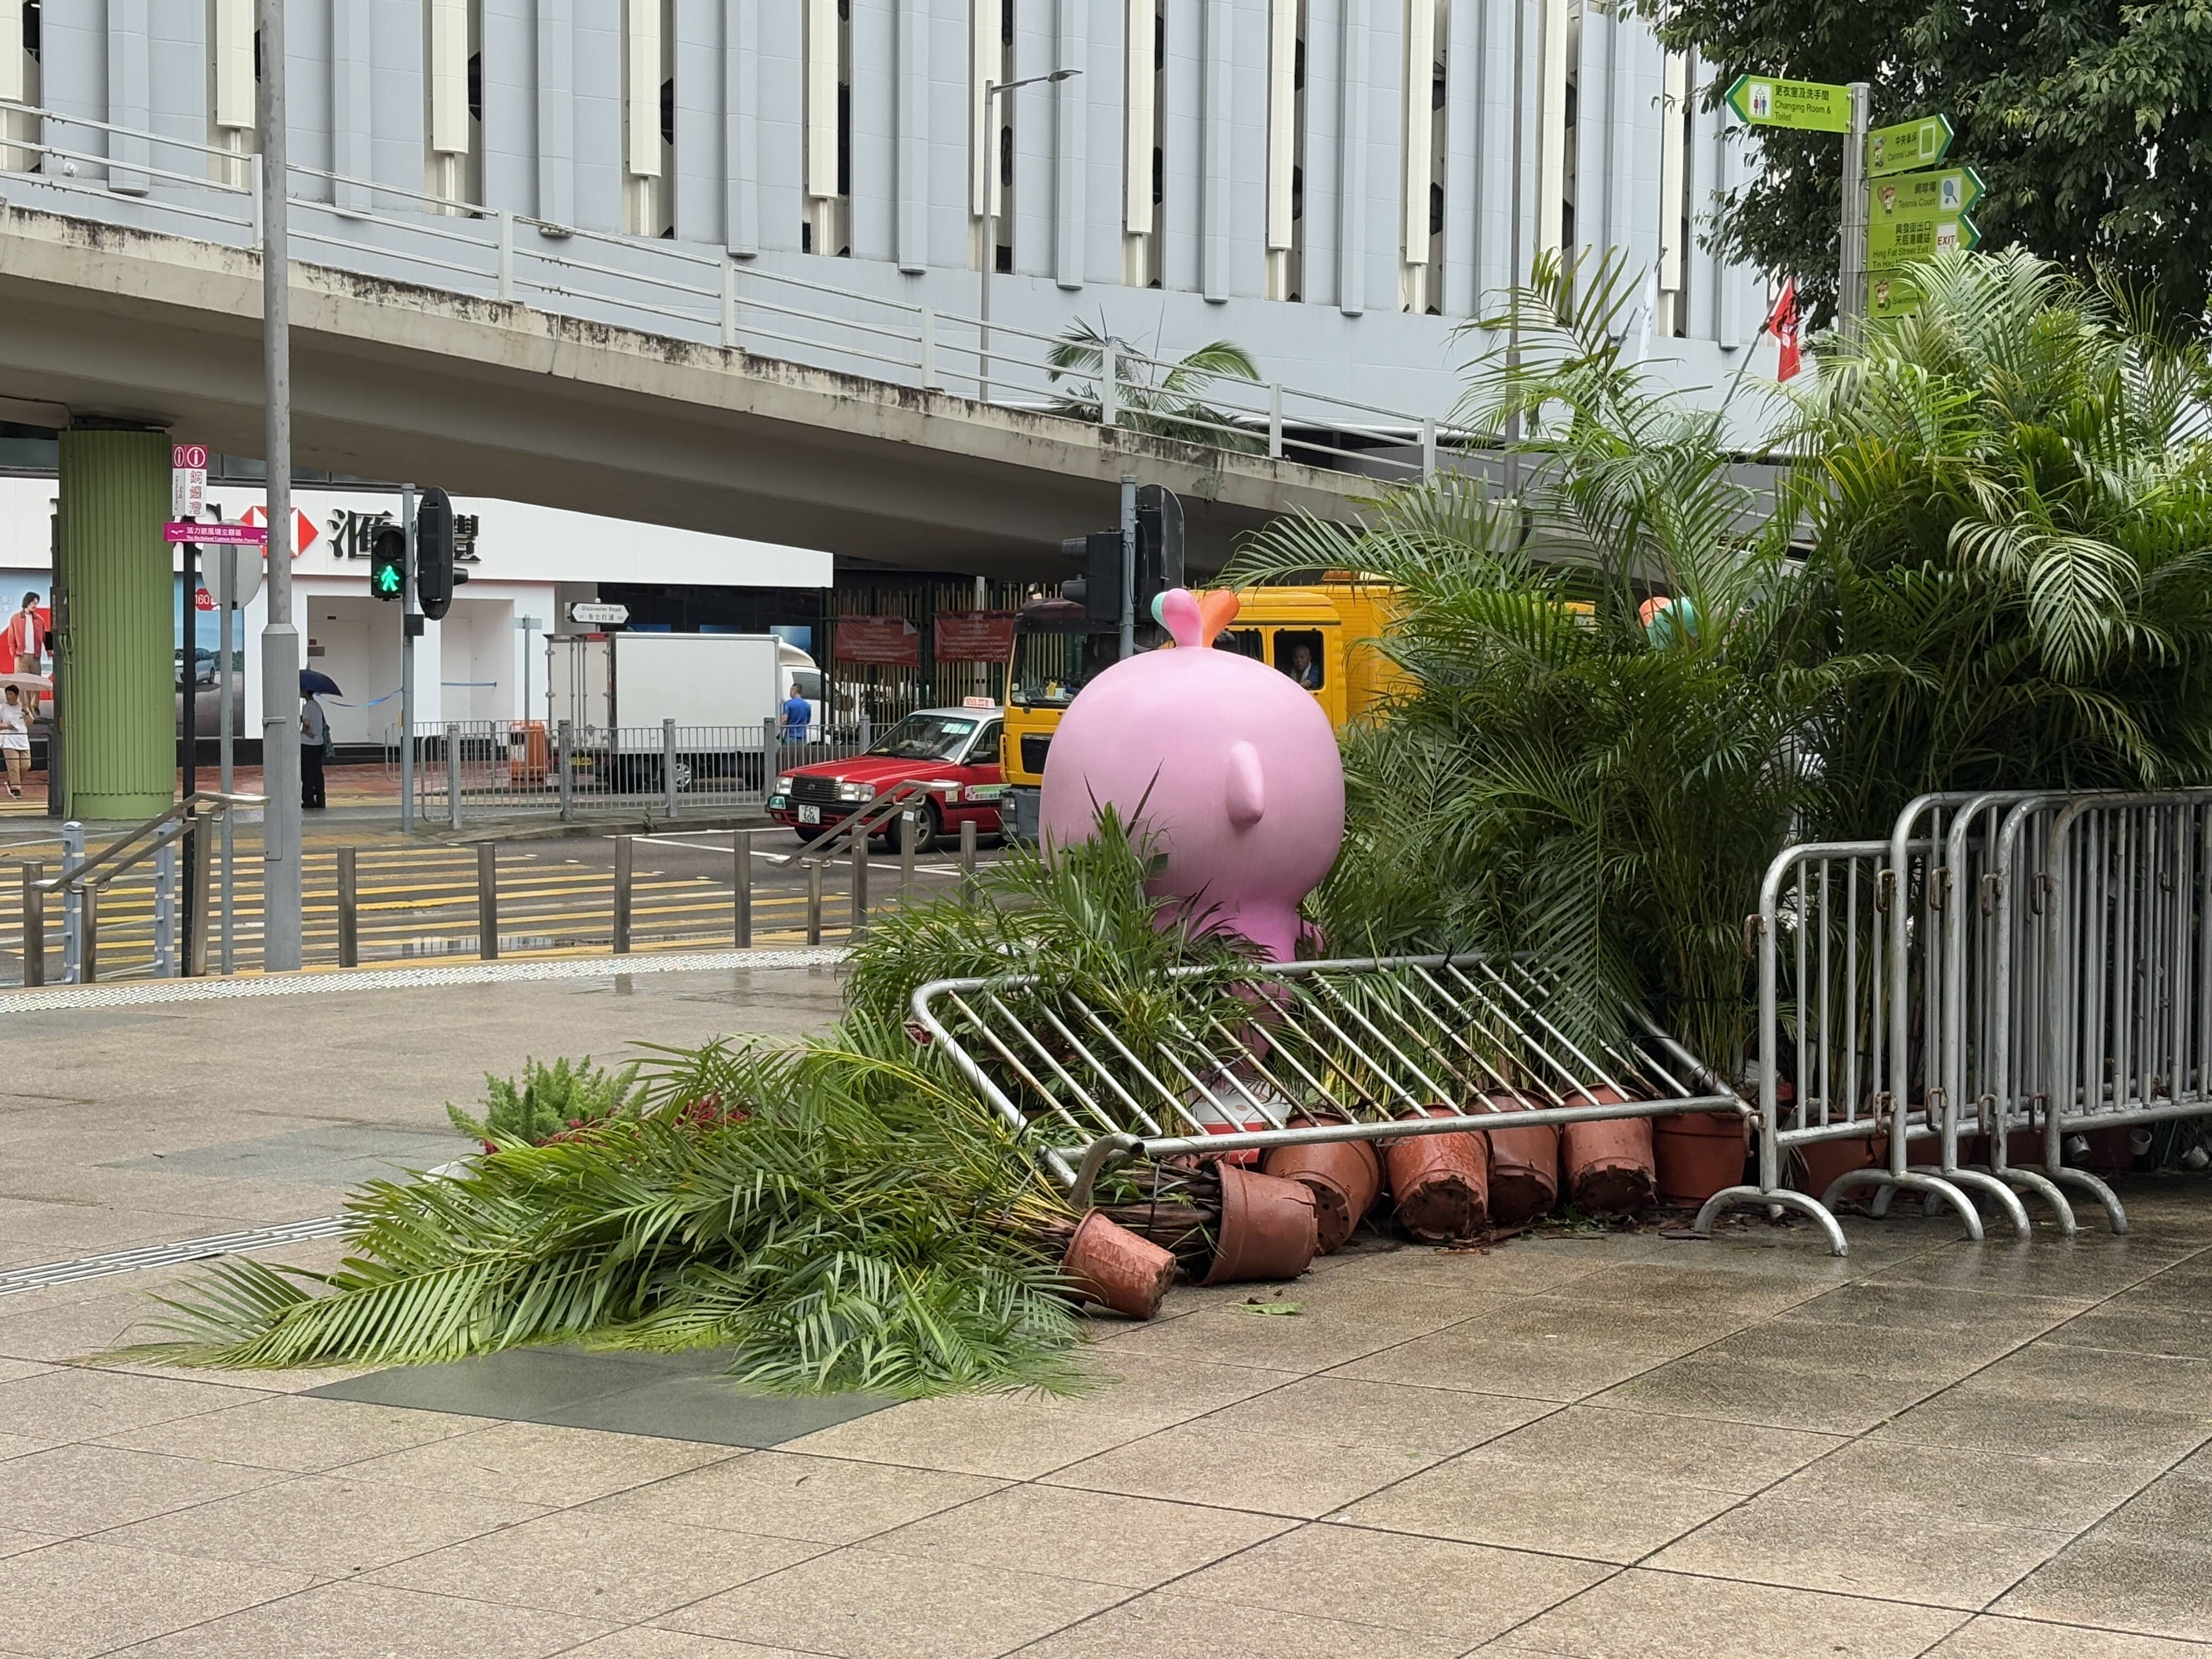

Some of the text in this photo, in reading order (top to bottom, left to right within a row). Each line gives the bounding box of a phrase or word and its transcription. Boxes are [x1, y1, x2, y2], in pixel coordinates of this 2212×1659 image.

[1775, 85, 1829, 101] 更衣室及洗手間
[1775, 100, 1805, 114] Changing
[1807, 104, 1825, 114] Room
[1774, 111, 1792, 121] Toilet
[1898, 198, 1936, 208] Tennis Court
[1937, 235, 1956, 246] EXIT
[1887, 248, 1898, 257] Fat
[1898, 246, 1916, 256] Street
[1892, 296, 1923, 305] Swimmin
[190, 470, 202, 515] 銅鑼灣
[966, 698, 989, 707] TAXI
